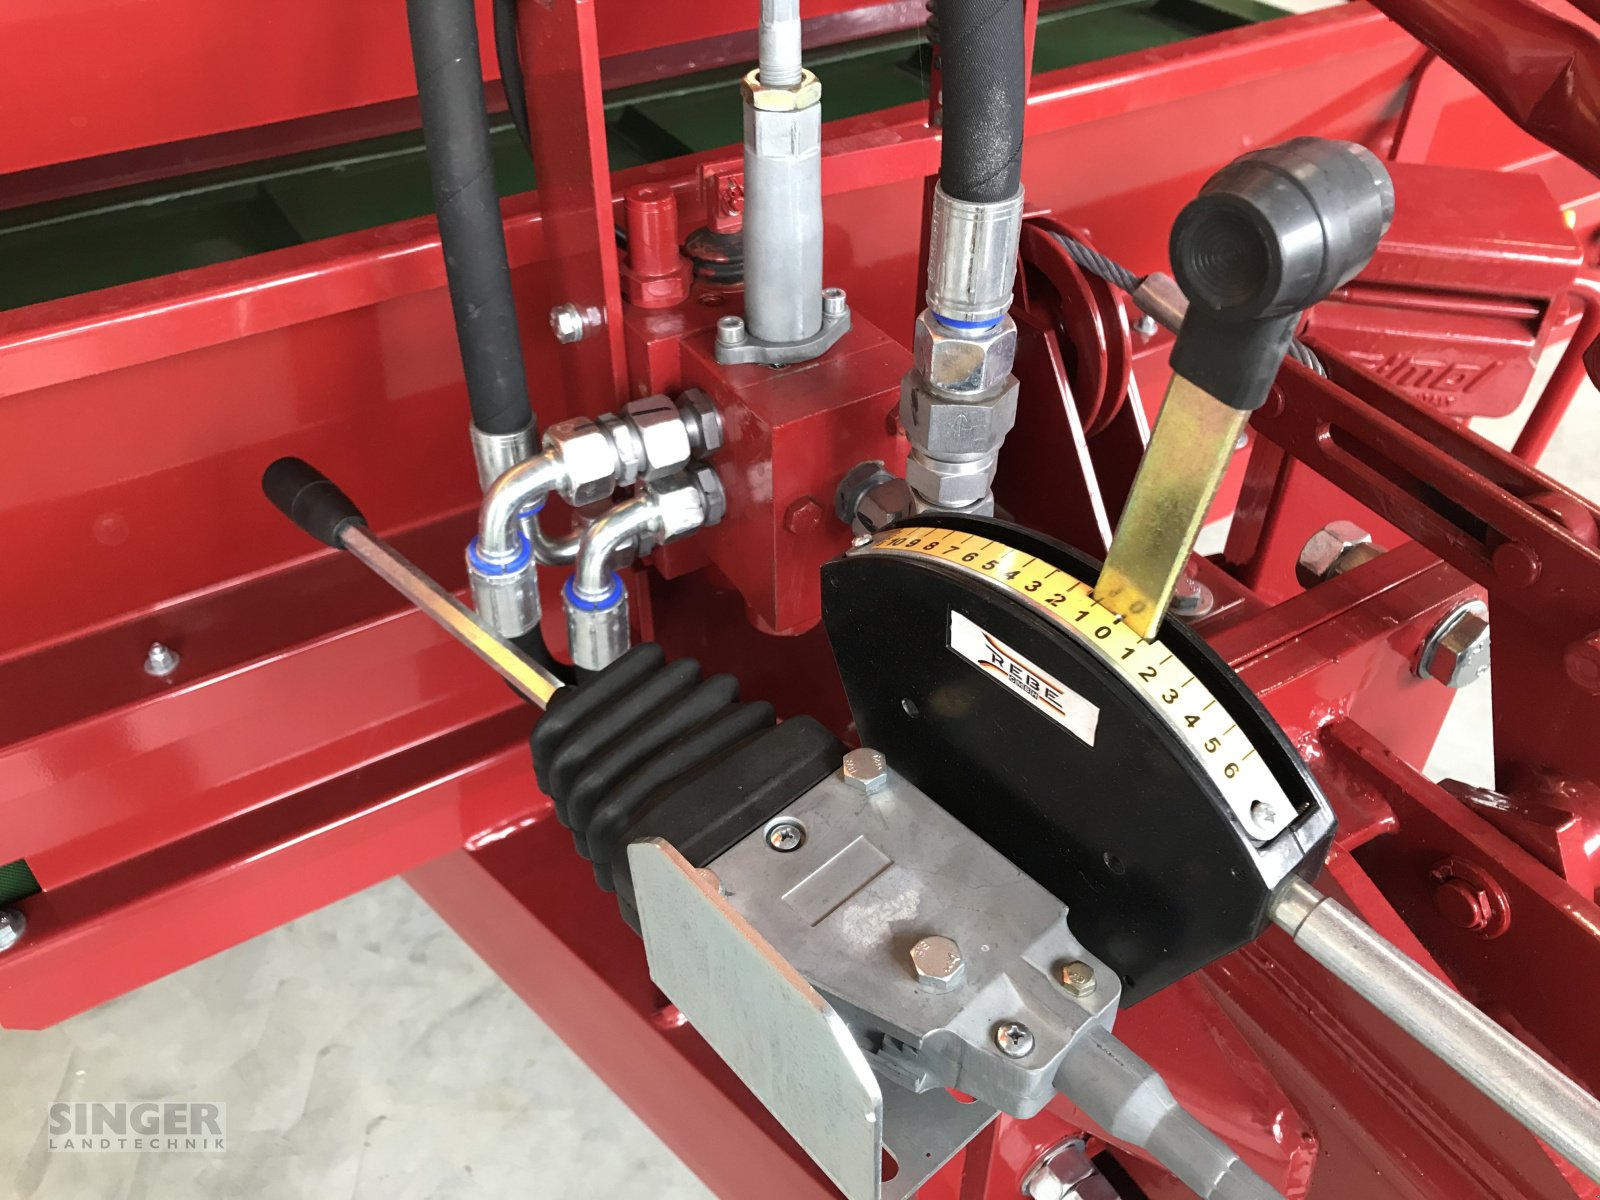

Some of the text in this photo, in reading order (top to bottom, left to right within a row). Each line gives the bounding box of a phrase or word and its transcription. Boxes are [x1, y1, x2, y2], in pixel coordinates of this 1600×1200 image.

[887, 537, 1240, 779] 10 9 8 7 6 5 4 3 2 1 0 1 2 3 4 5 6
[987, 646, 1063, 709] REBE
